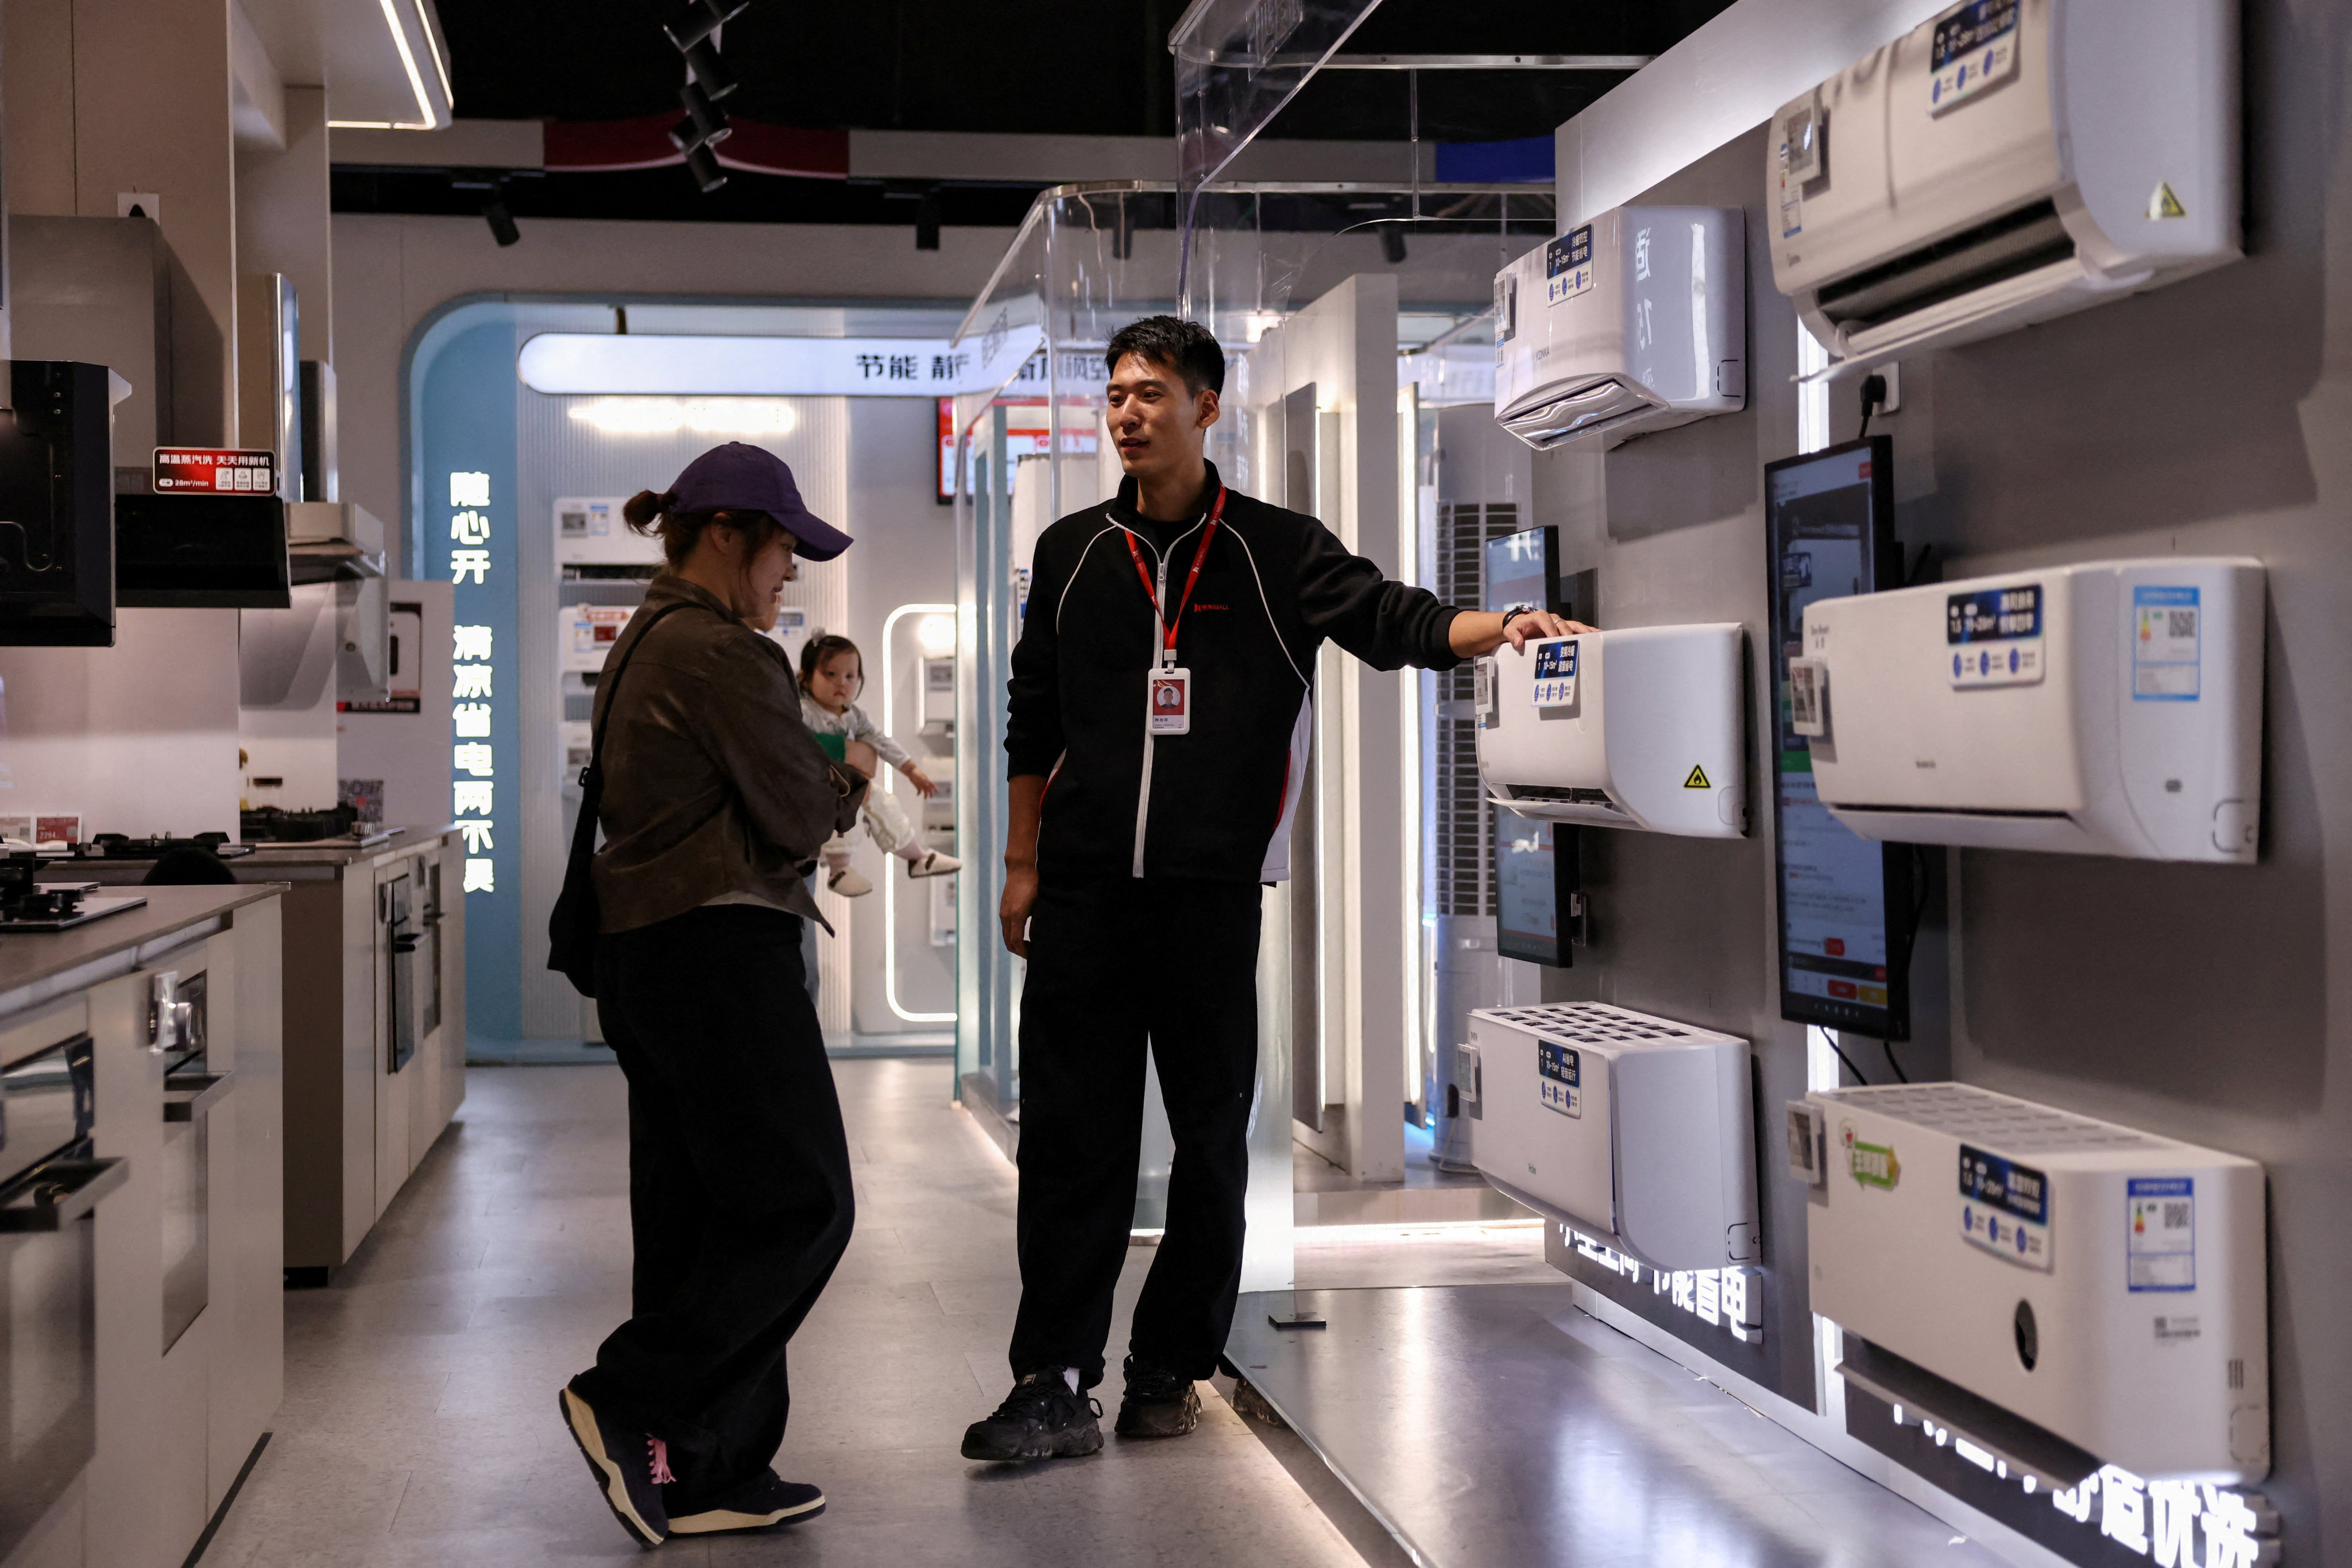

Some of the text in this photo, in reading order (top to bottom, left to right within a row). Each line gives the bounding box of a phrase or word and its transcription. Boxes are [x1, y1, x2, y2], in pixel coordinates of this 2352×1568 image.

[1572, 231, 1588, 248] 冷暖双控
[1572, 246, 1588, 263] 节能省电
[1535, 346, 1550, 361] KONKA
[856, 354, 918, 380] 节能
[159, 454, 270, 466] 高温蒸汽洗 天天用新机
[1558, 660, 1573, 672] 超级省电
[1562, 1052, 1574, 1067] AI省电
[1561, 1066, 1576, 1082] 轻音运行
